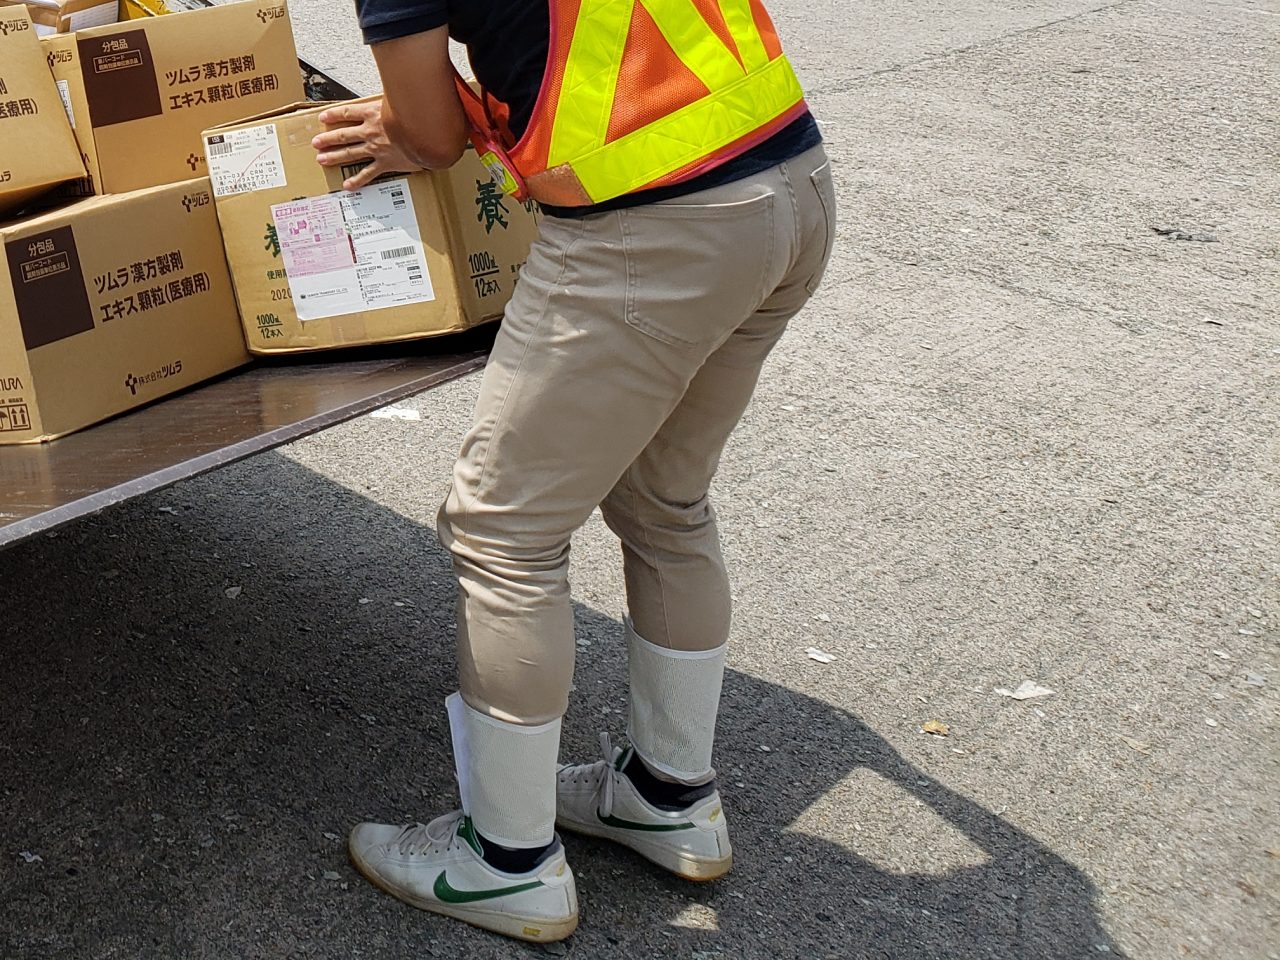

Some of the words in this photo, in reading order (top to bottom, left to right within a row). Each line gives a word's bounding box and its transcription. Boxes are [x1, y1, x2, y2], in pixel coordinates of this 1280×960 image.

[266, 7, 285, 20] ツムラ
[8, 20, 29, 32] ツムラ
[102, 38, 129, 53] 分包品
[55, 51, 73, 63] ツムラ
[191, 193, 210, 208] ツムラ
[28, 238, 55, 257] 分包品
[474, 278, 501, 299] 12本入
[261, 327, 284, 339] 12本入
[138, 360, 183, 387] 株式会社ツムラ
